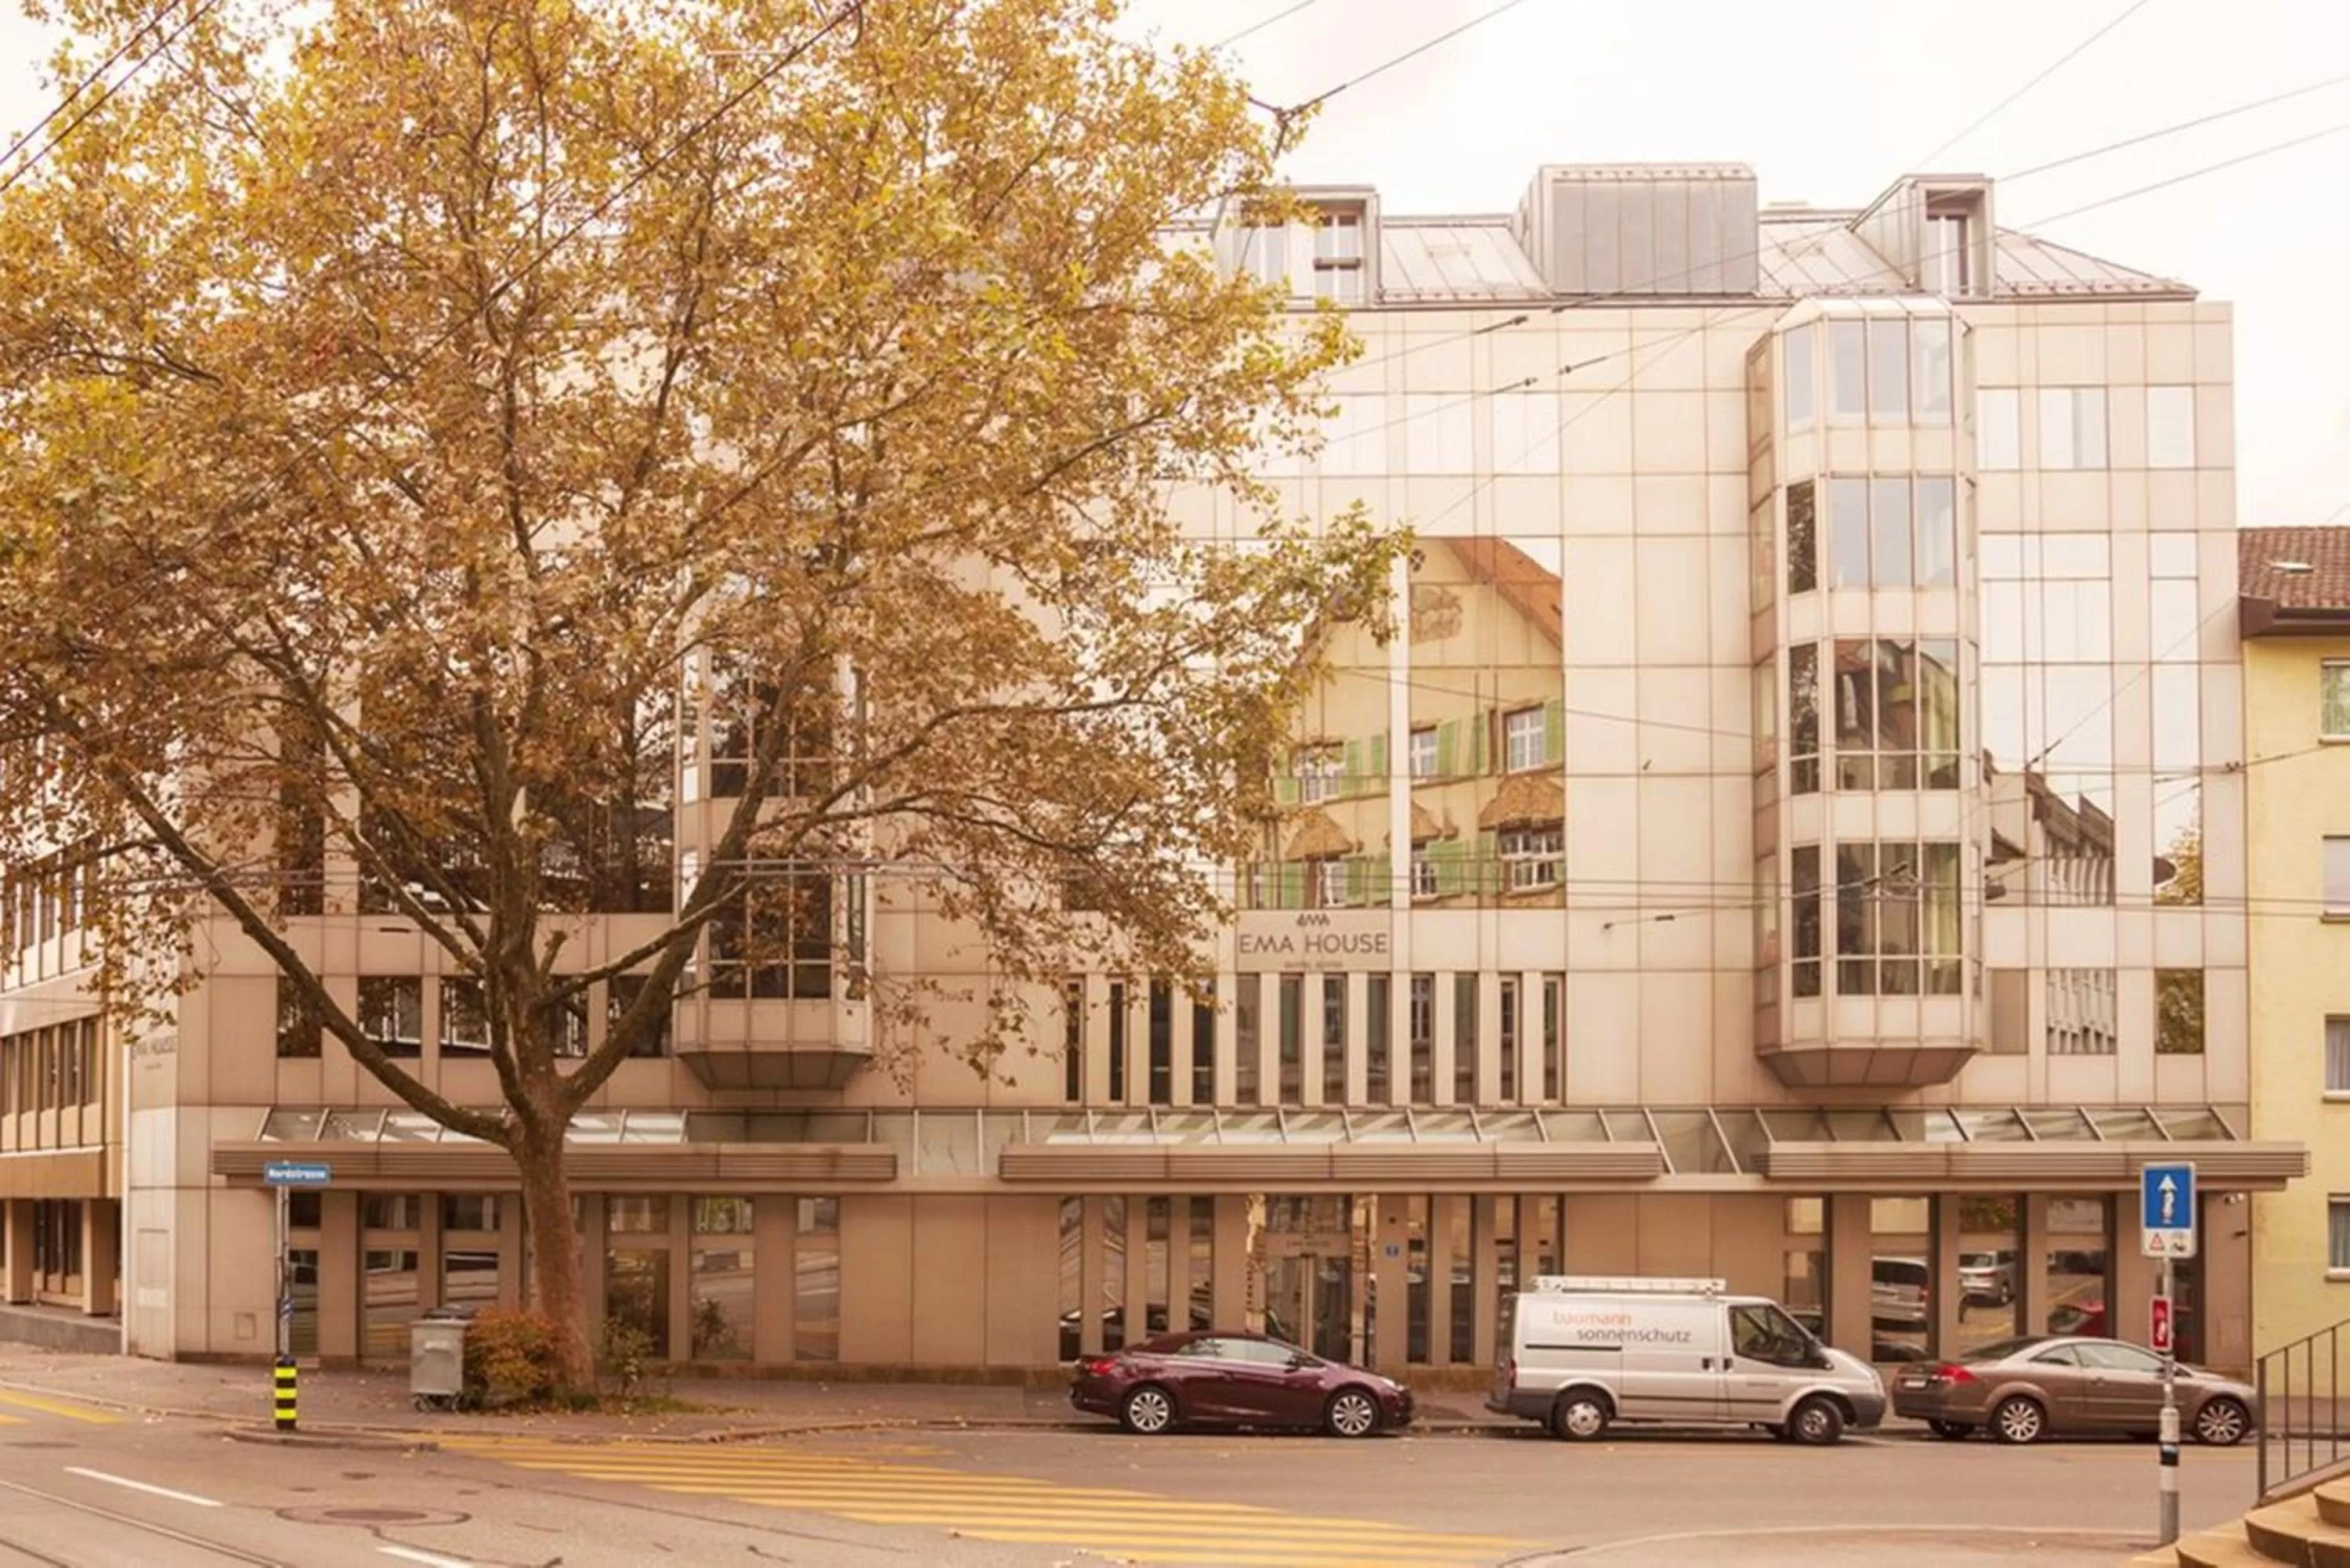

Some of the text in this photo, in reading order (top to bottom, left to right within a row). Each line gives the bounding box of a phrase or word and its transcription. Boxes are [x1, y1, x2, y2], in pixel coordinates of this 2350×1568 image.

[1238, 932, 1389, 954] EMA HOUSE
[1553, 1311, 1632, 1325] baumann
[1577, 1327, 1693, 1342] sonnenschutz
